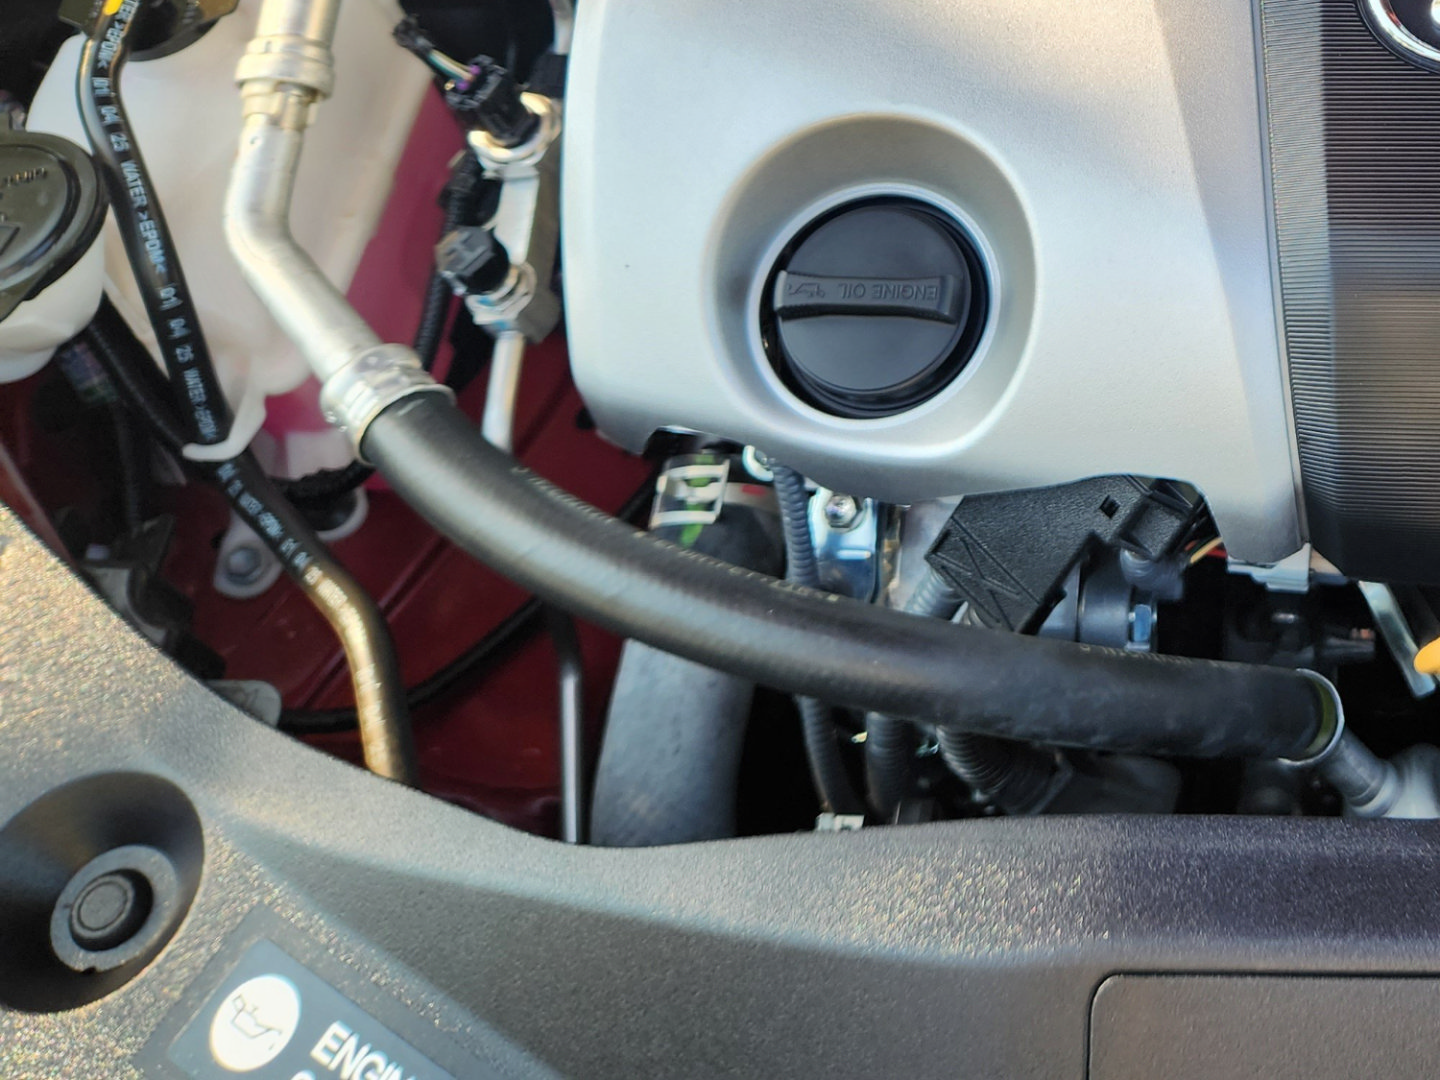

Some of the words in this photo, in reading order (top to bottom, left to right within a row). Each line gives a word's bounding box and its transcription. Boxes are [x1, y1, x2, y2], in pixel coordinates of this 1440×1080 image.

[120, 159, 148, 208] WATER
[838, 283, 866, 300] OIL
[872, 284, 938, 301] ENGINE
